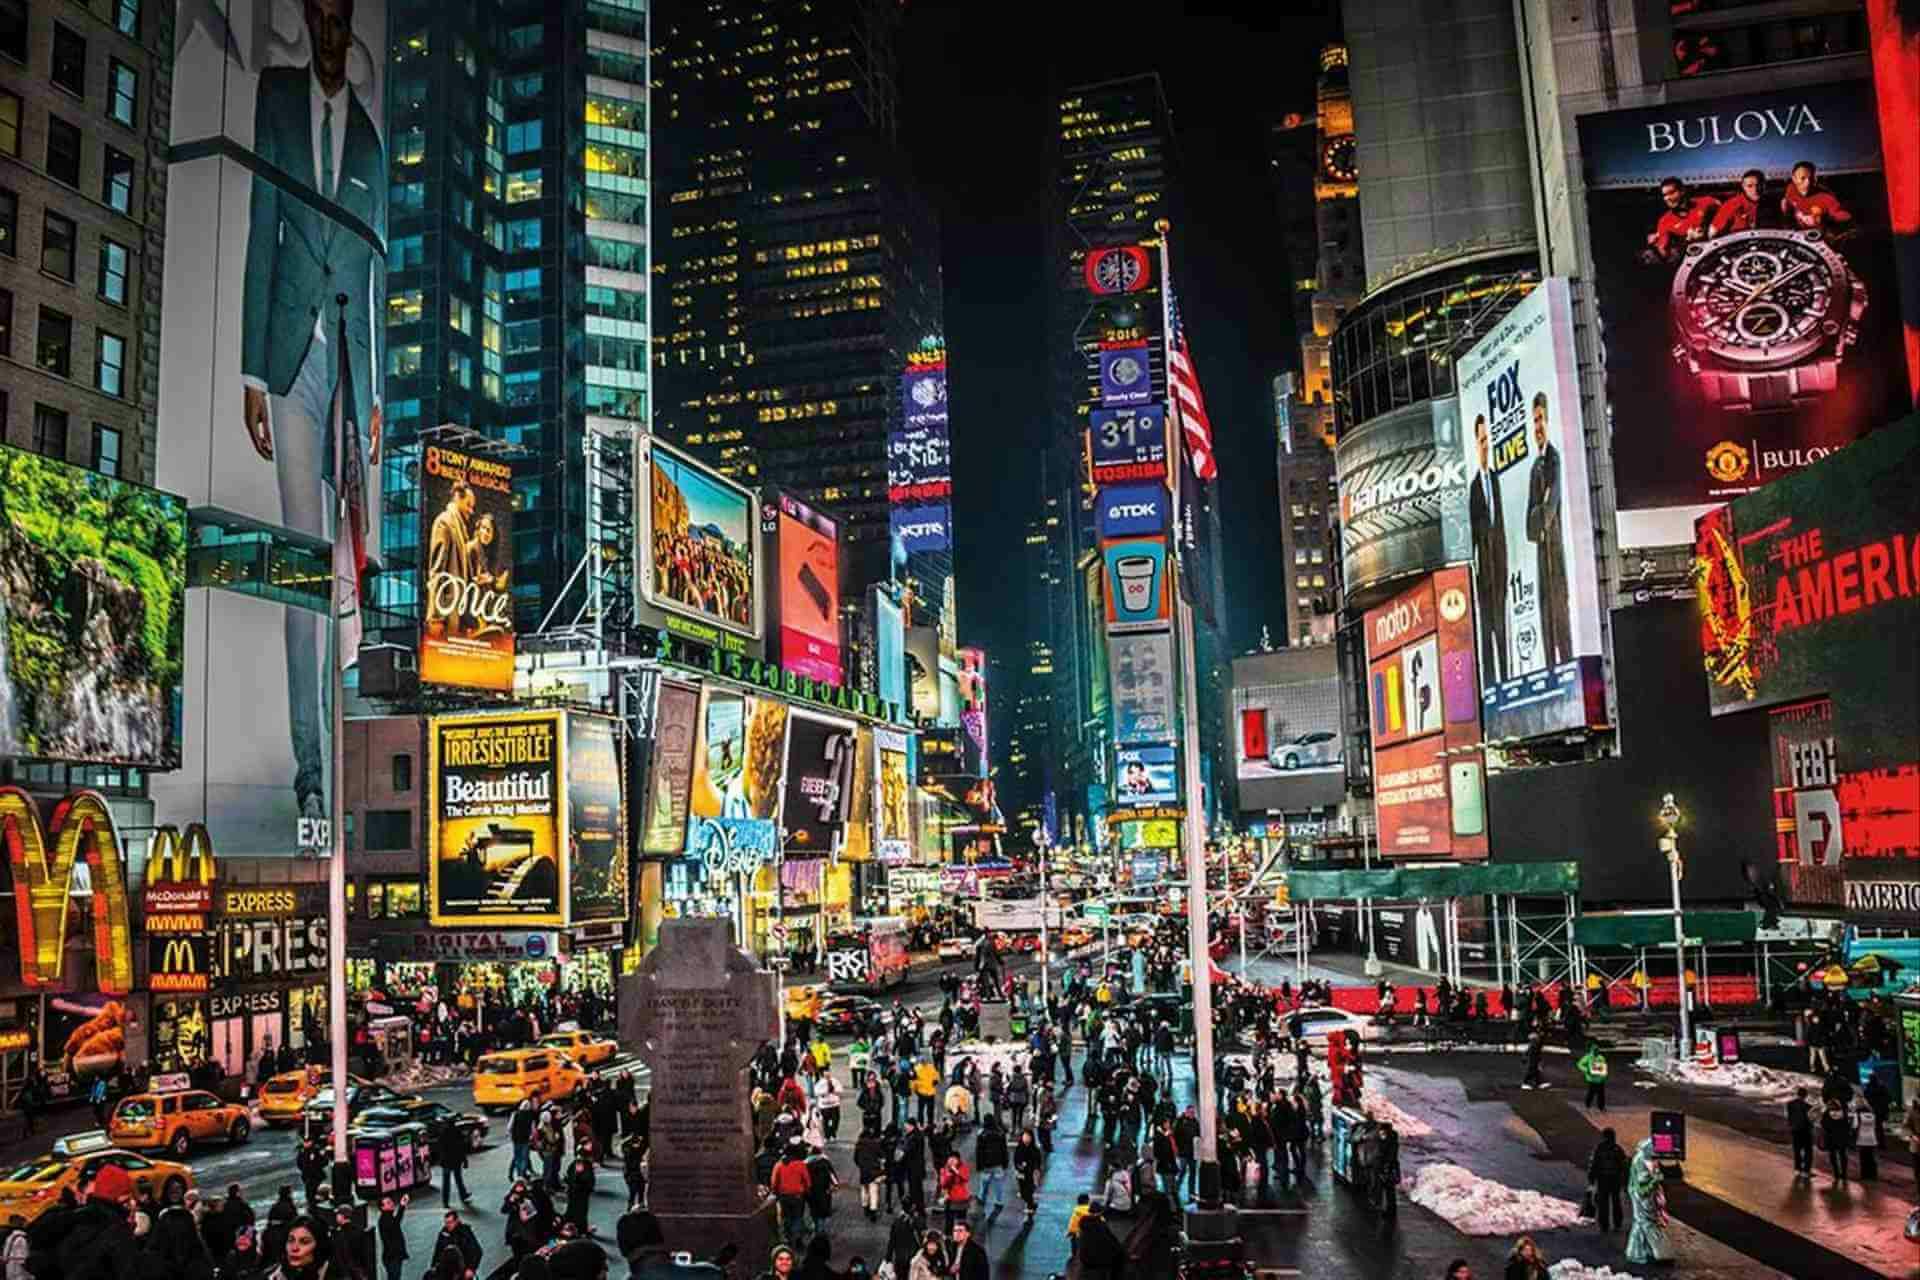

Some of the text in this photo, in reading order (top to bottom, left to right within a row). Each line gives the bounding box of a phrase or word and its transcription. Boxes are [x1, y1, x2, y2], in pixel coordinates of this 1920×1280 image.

[1646, 103, 1824, 154] BULOVA
[1487, 359, 1524, 421] FOX
[426, 446, 440, 475] 8
[1495, 434, 1529, 468] LIVE
[1094, 463, 1166, 482] TOSHIBA
[1120, 503, 1157, 518] TDK
[1780, 527, 1823, 570] THE
[427, 572, 512, 628] Once
[1376, 602, 1409, 645] moto
[445, 769, 551, 803] Beautiful
[145, 890, 210, 902] McDonald's
[226, 891, 296, 913] EXPRESS
[414, 934, 507, 948] DIGITAL
